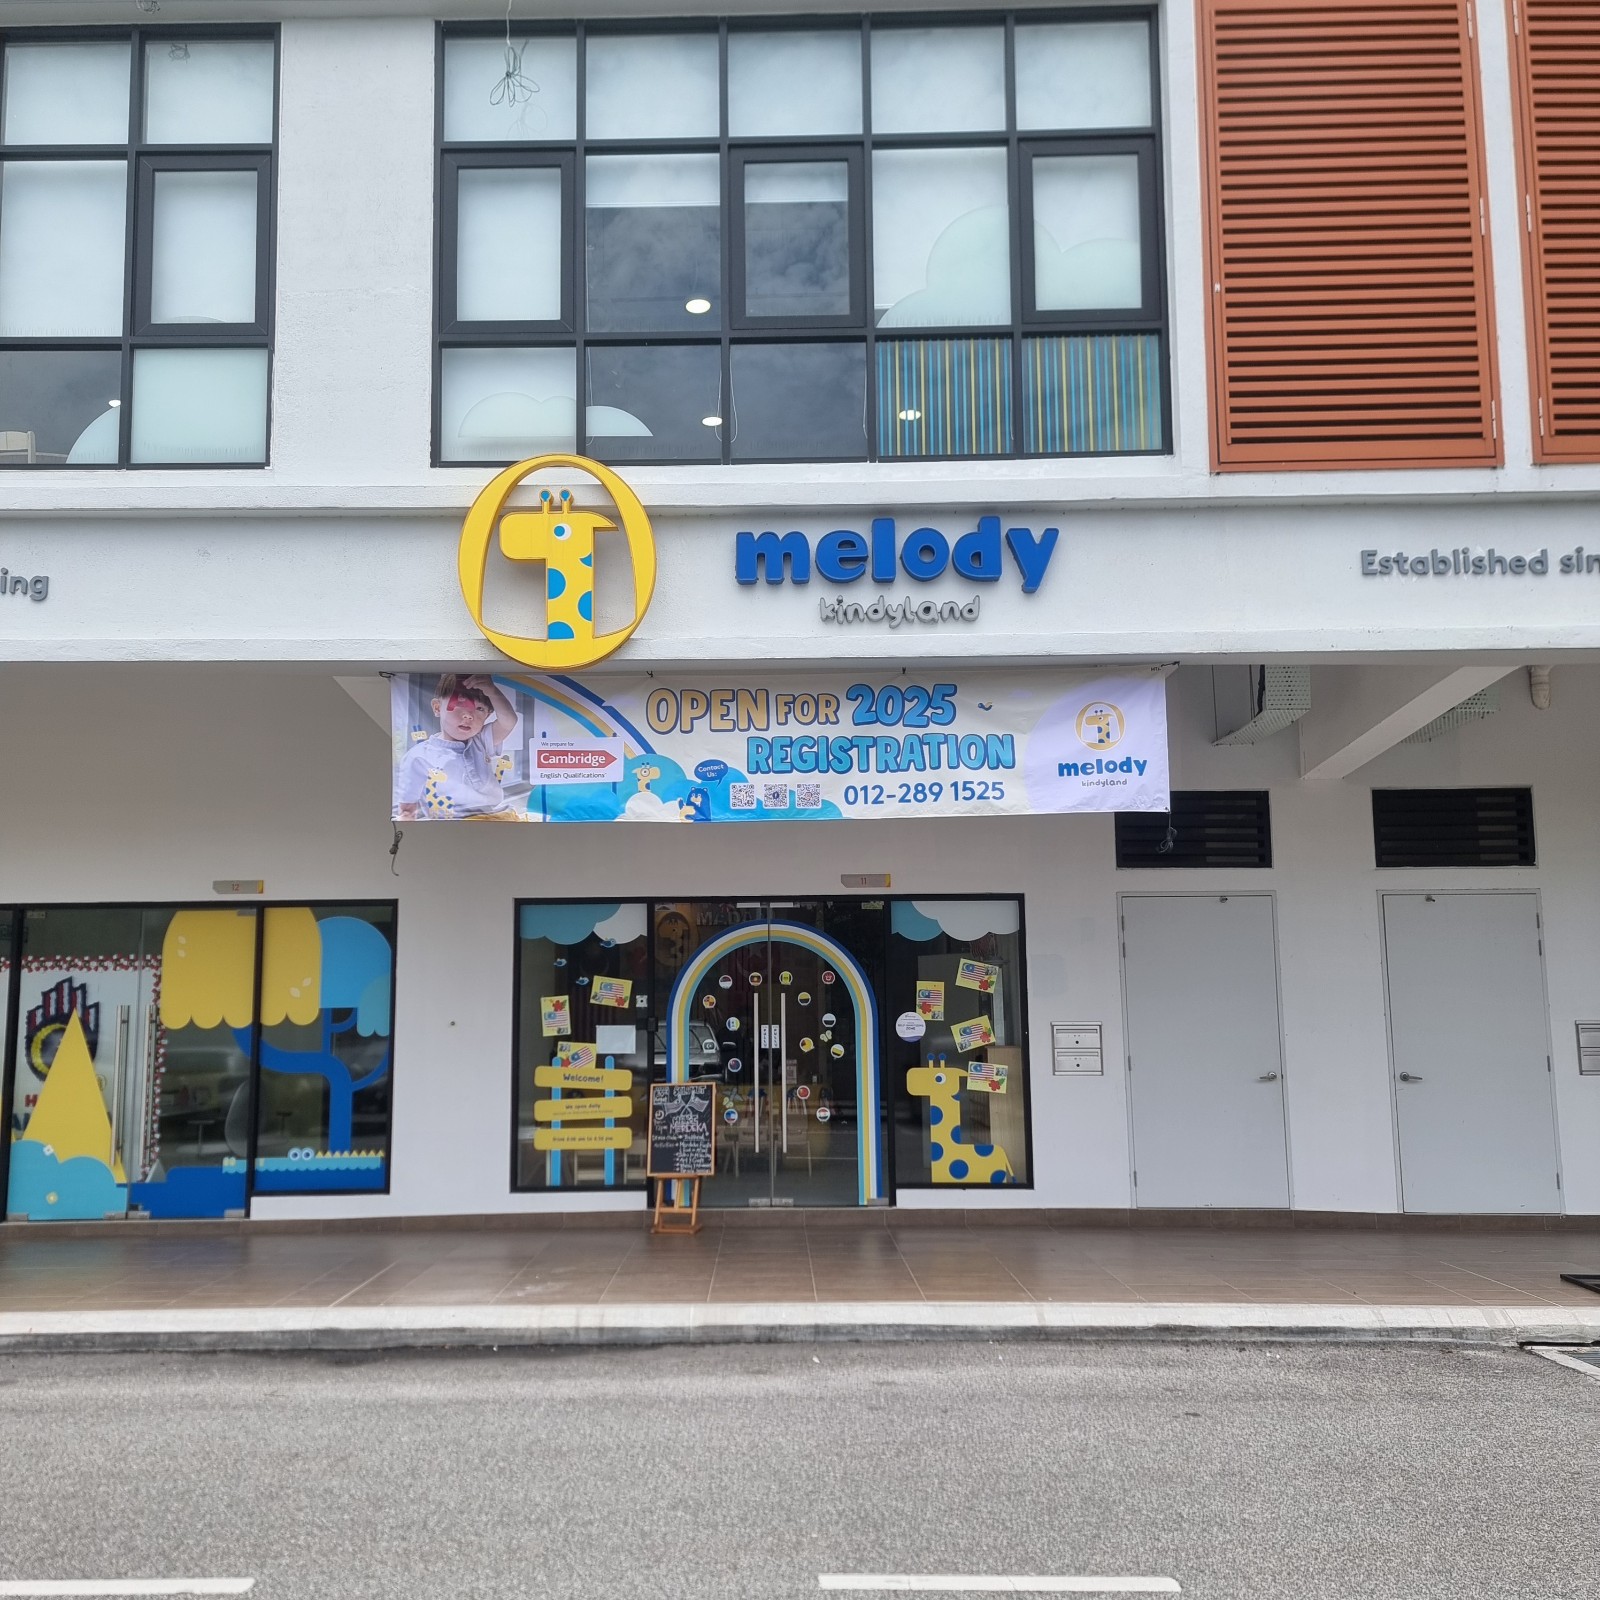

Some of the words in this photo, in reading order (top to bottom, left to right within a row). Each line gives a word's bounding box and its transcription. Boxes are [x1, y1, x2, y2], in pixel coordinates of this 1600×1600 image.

[735, 515, 1060, 594] melody
[1360, 546, 1550, 576] Established
[0, 567, 50, 602] ing
[818, 594, 981, 630] kindyland
[645, 687, 770, 735] OPEN
[775, 693, 841, 726] FOR
[845, 683, 958, 728] 2025
[540, 752, 606, 767] Cambridge
[746, 732, 1016, 775] REGISTRATION
[1057, 756, 1148, 777] melody
[540, 772, 562, 780] English
[697, 764, 724, 773] Contact
[843, 781, 944, 807] 012-289
[952, 780, 1006, 803] 1525
[1081, 778, 1128, 788] kindyland
[562, 1073, 604, 1083] Welcome!
